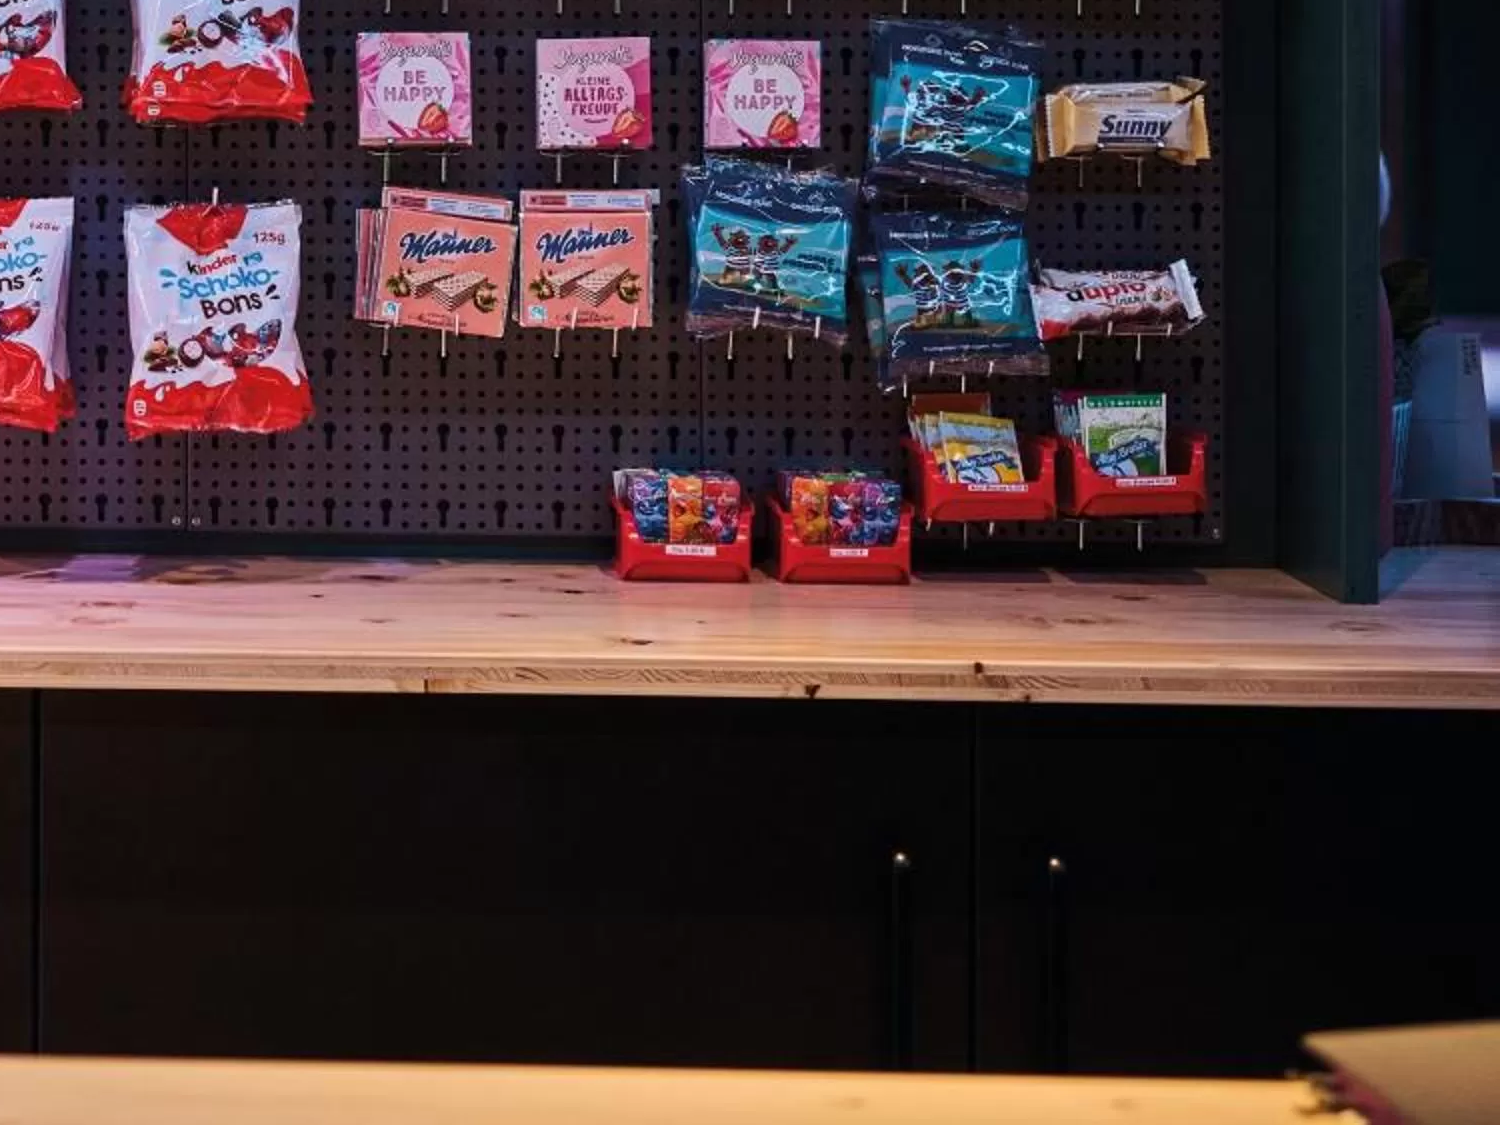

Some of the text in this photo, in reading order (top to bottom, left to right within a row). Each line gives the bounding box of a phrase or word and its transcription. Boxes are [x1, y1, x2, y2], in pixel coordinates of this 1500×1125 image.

[403, 70, 428, 85] BE
[753, 78, 777, 94] BE
[383, 86, 447, 102] HAPPY
[733, 94, 796, 110] HAPPY
[1098, 114, 1173, 141] Sunny
[399, 228, 497, 264] Manner
[536, 227, 635, 264] Manner
[200, 292, 263, 320] Bons
